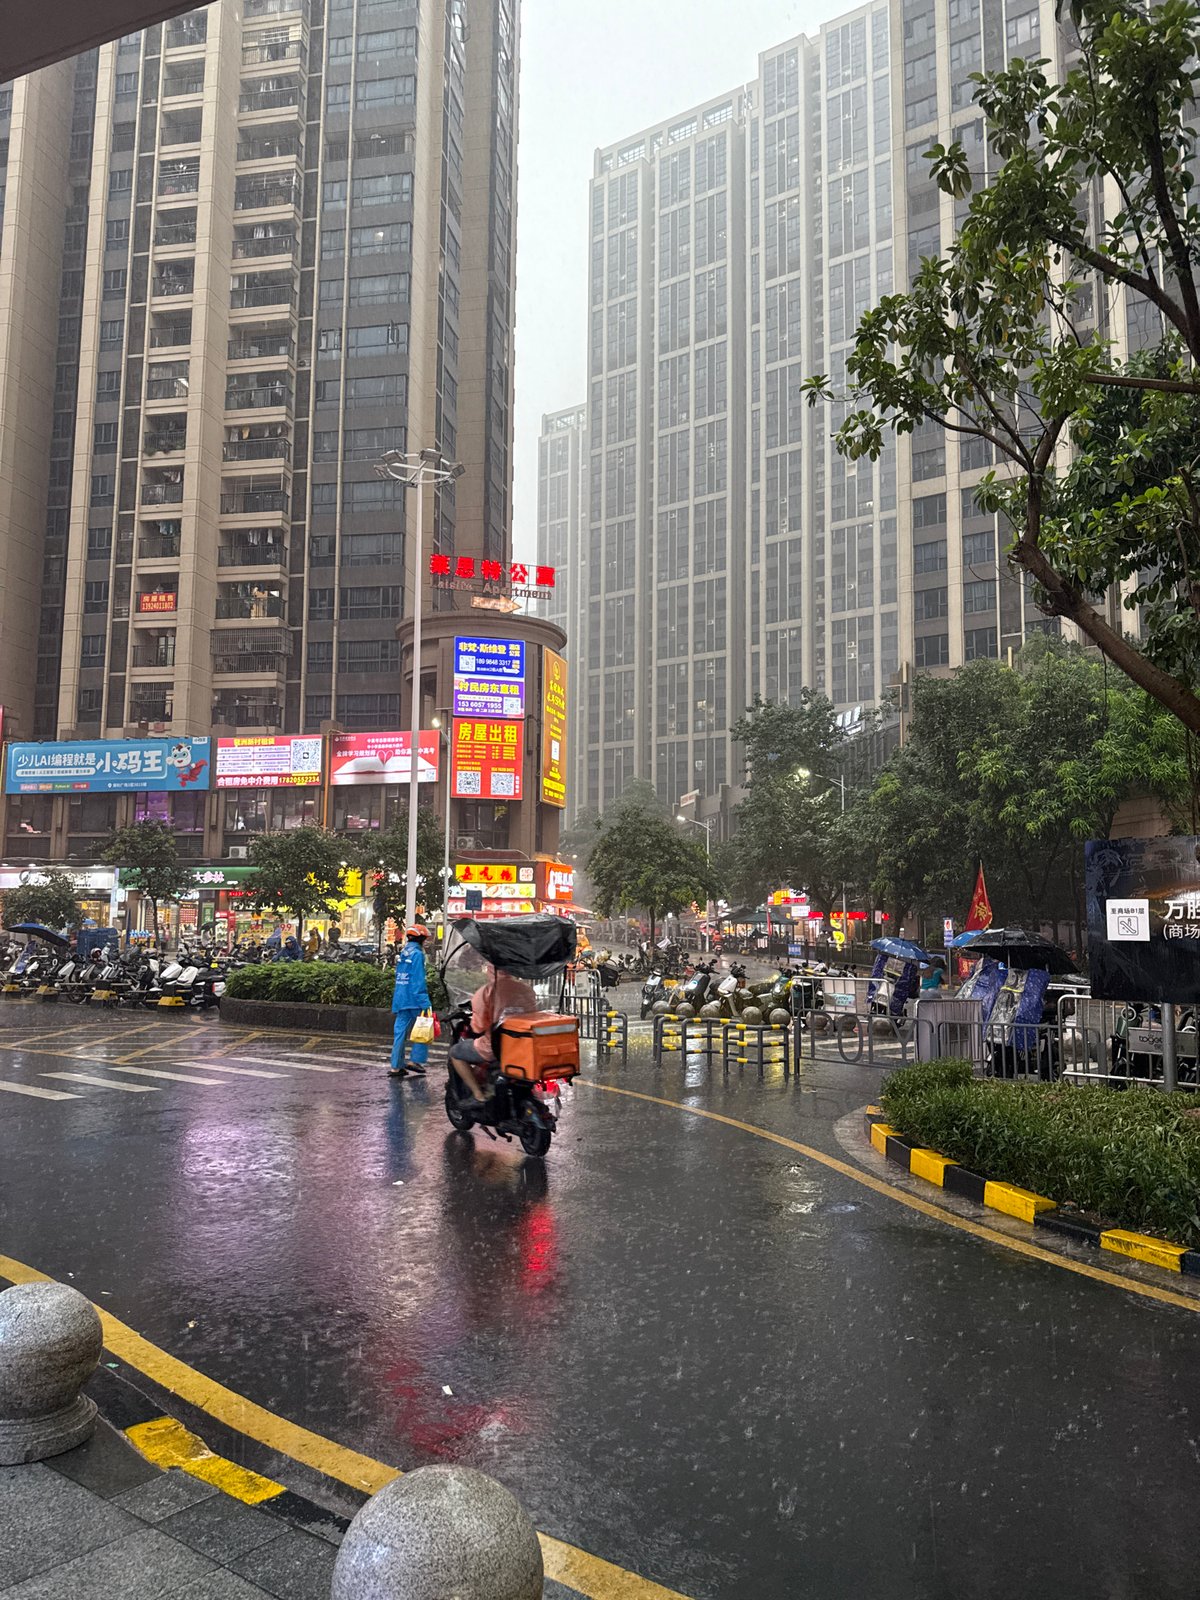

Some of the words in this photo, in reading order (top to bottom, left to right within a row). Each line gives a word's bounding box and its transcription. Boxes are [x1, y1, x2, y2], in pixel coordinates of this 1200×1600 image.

[458, 723, 517, 743] 房屋出租
[17, 753, 96, 767] 少儿AI编程就是
[96, 750, 162, 774] 小码王
[279, 776, 320, 784] 17820552234
[1110, 907, 1145, 915] 至商场B1层
[1163, 923, 1200, 941] (商场
